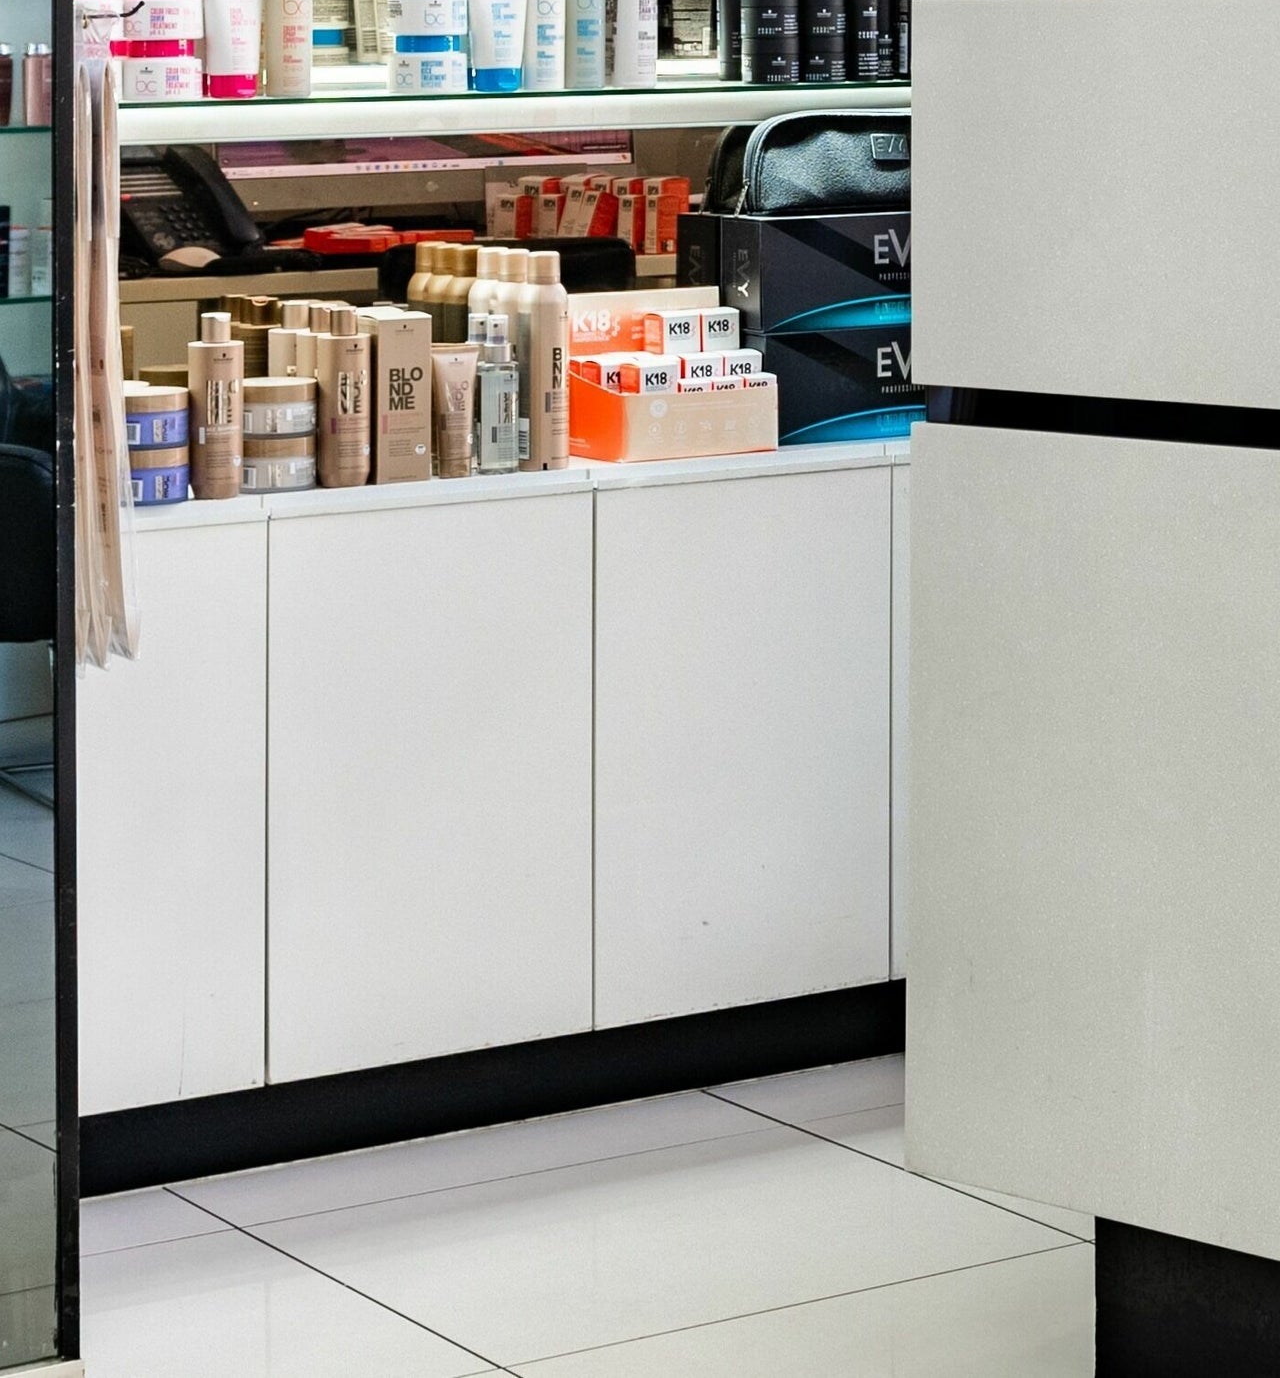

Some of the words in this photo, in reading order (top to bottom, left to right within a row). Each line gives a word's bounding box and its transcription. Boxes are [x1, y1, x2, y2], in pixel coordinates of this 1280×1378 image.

[874, 228, 912, 268] EV
[572, 309, 611, 332] K18
[708, 319, 730, 333] K18
[669, 322, 691, 335] K18
[876, 341, 912, 380] EV
[389, 367, 424, 383] BLO
[690, 364, 713, 378] K18
[730, 362, 752, 376] K18
[606, 372, 621, 384] K1
[645, 372, 668, 386] K18
[389, 383, 414, 397] ND
[389, 397, 416, 411] ME
